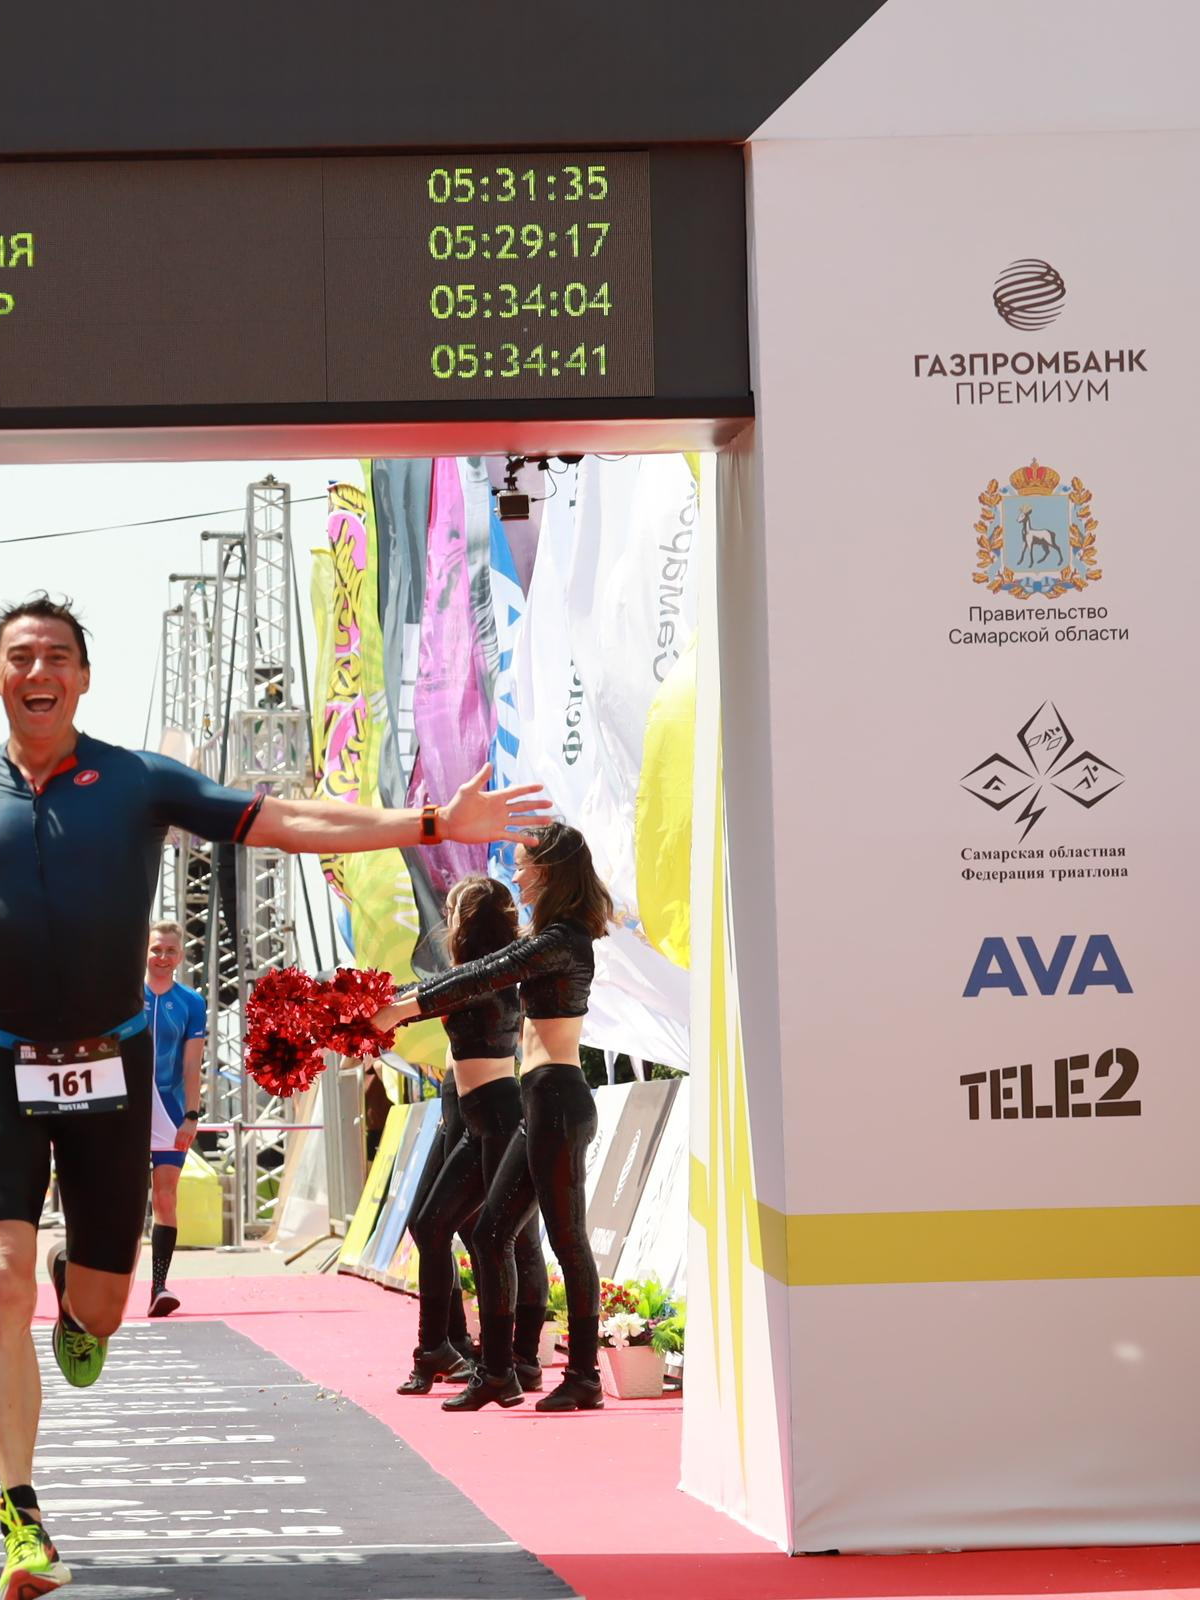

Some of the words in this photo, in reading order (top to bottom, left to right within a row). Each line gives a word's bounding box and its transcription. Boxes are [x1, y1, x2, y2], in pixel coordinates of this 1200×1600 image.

[429, 165, 608, 203] 05:31:35
[431, 223, 609, 260] 05:29:17
[431, 283, 609, 319] 05:34:04
[432, 343, 606, 379] 05:34:41
[913, 348, 1148, 378] ГАЗПРОМБАНК
[955, 378, 1109, 406] ПРЕМИУМ
[969, 605, 1108, 626] Правительство
[948, 626, 1049, 648] Самарской
[1054, 625, 1129, 642] области
[960, 847, 1045, 864] Самарская
[1048, 845, 1126, 859] областная
[961, 867, 1045, 884] Федерация
[1048, 867, 1129, 882] триатлона
[961, 933, 1135, 998] AVA
[47, 1069, 93, 1097] 161
[959, 1047, 1142, 1121] TELE2
[57, 1101, 90, 1112] RUSTAM
[90, 1552, 366, 1565] STAR
